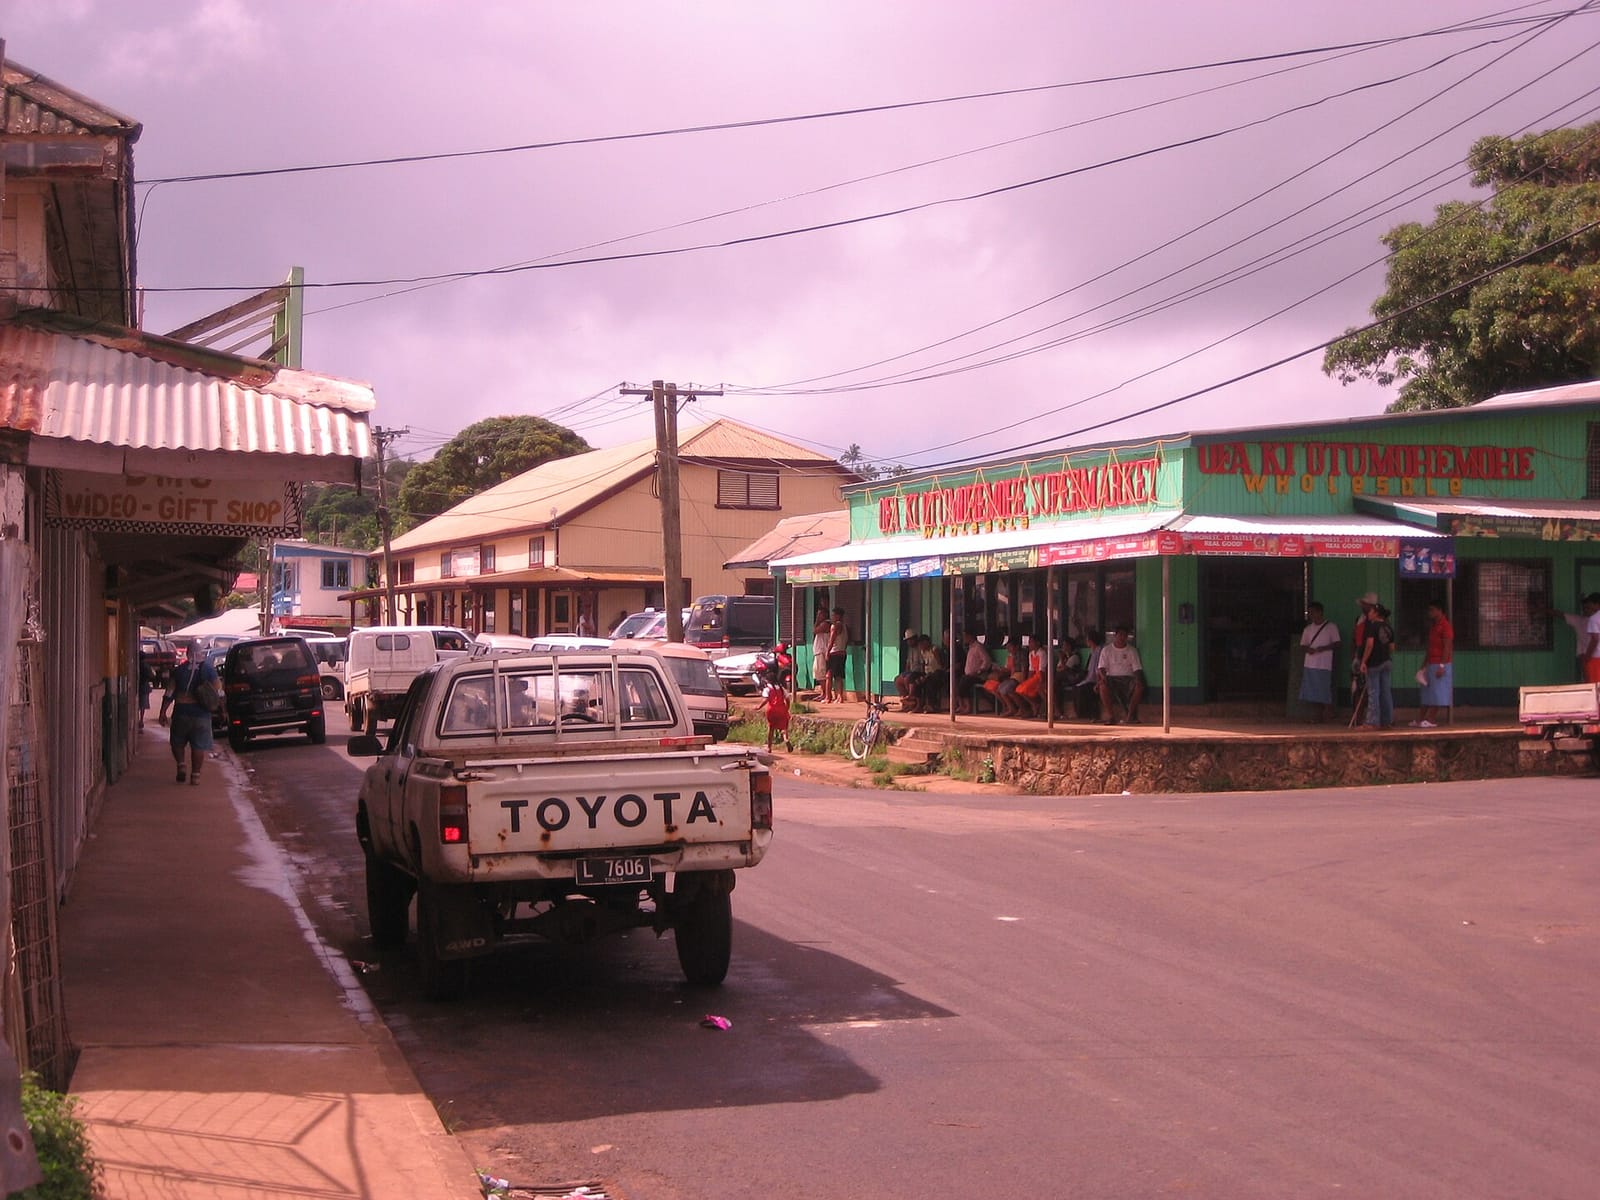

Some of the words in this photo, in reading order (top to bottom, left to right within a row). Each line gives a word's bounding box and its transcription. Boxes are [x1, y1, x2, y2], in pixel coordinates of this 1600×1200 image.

[1260, 442, 1296, 476] KI
[905, 493, 921, 530] KI
[1031, 458, 1159, 516] SUPERMARKET
[226, 499, 283, 524] SHOP
[500, 791, 717, 833] TOYOTA
[583, 861, 593, 878] L
[605, 859, 644, 877] 7606
